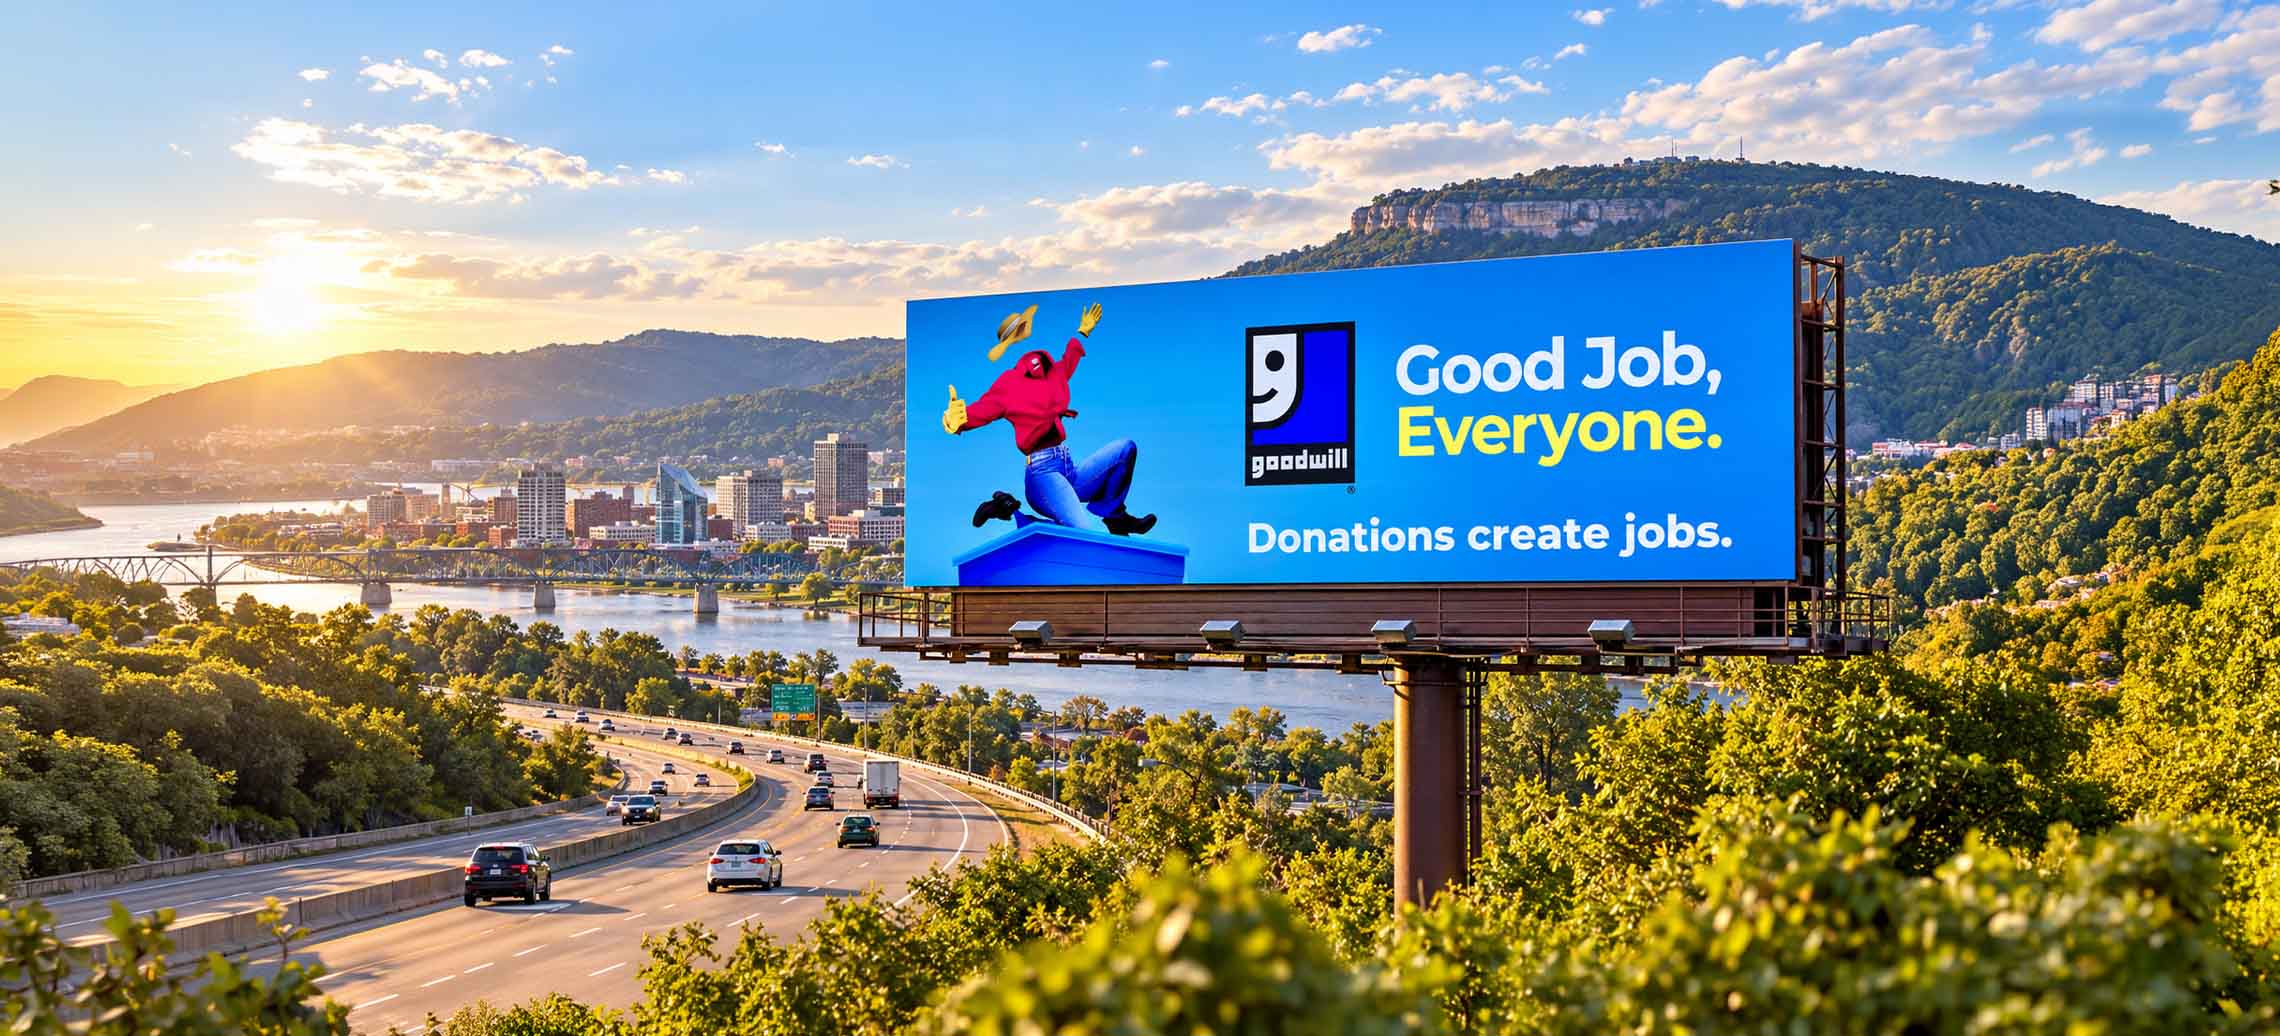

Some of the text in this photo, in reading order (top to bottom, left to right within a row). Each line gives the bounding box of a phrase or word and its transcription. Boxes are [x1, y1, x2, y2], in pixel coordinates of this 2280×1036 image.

[1396, 330, 1722, 396] Good Job,
[1398, 405, 1722, 467] Everyone.
[1252, 448, 1348, 479] goodwill
[1248, 511, 1732, 558] Donations create jobs.
